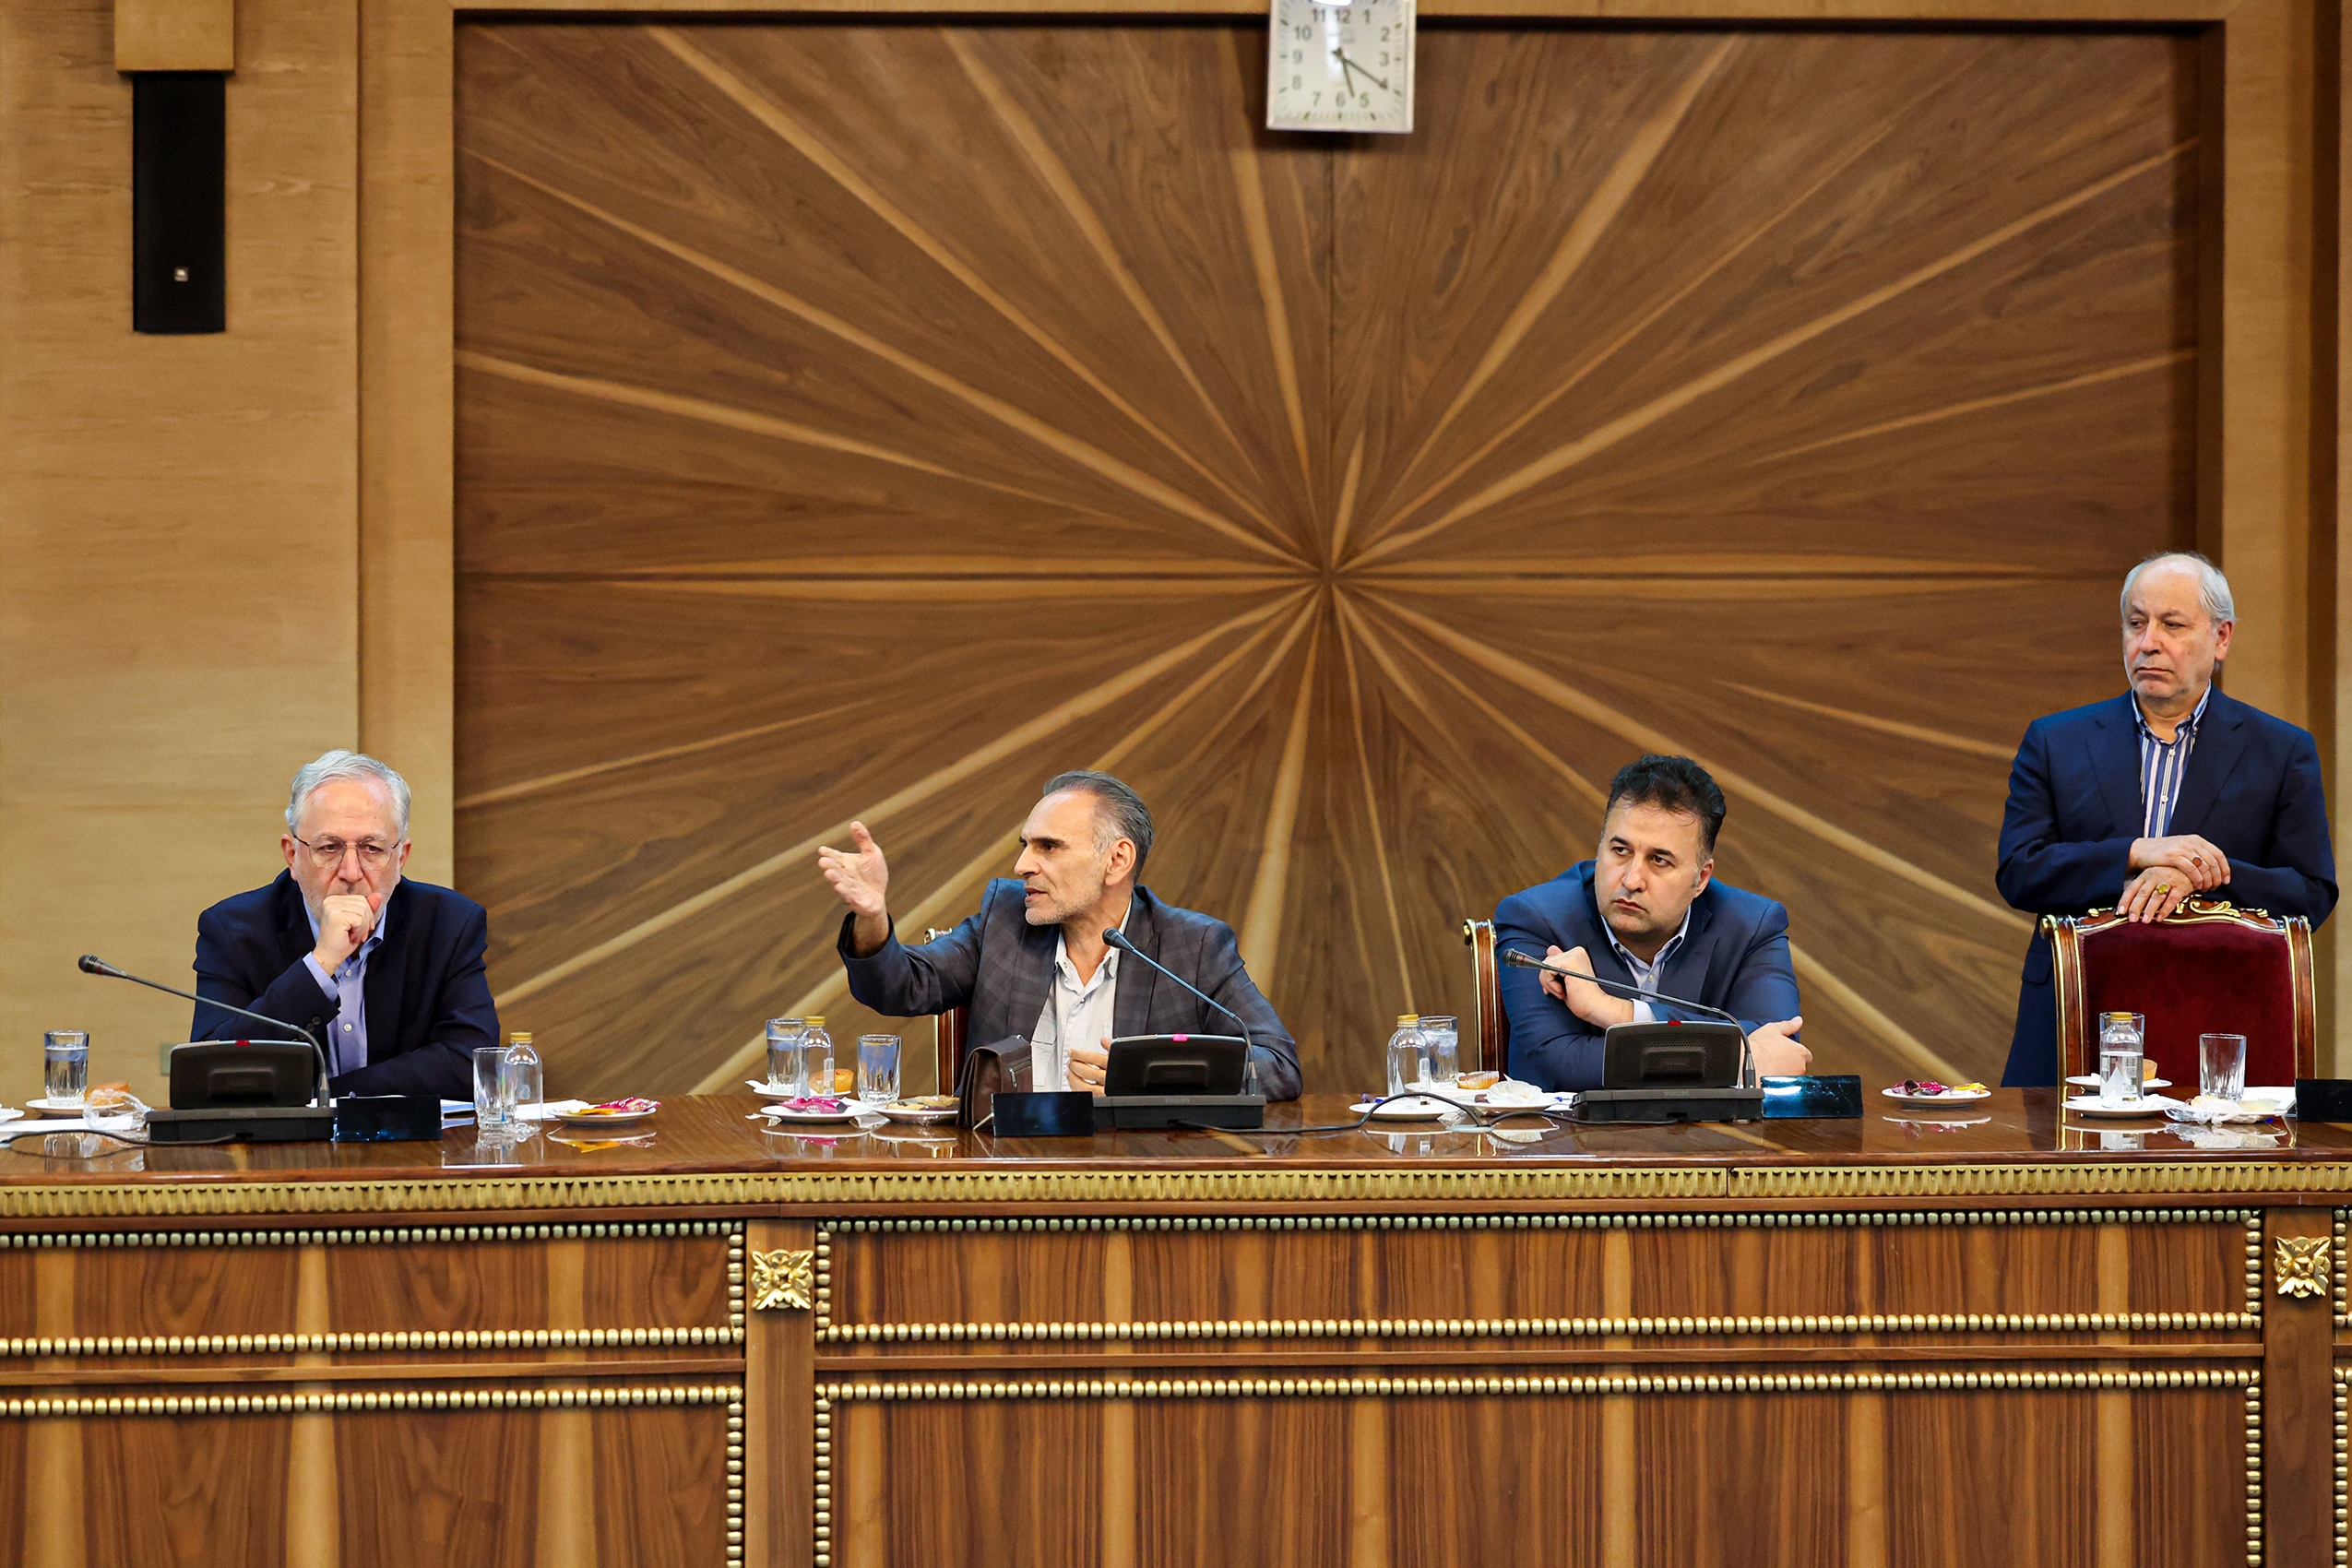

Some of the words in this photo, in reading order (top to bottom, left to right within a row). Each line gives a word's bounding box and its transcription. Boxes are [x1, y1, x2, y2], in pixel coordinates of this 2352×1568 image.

[1313, 8, 1326, 22] 11
[1336, 9, 1351, 24] 12
[1363, 9, 1371, 24] 1
[1295, 25, 1313, 41] 10
[1380, 26, 1390, 42] 2
[1292, 49, 1303, 65] 9
[1379, 51, 1389, 66] 3
[1291, 75, 1302, 90] 8
[1313, 91, 1322, 106] 7
[1336, 92, 1346, 108] 6
[1360, 92, 1370, 109] 5
